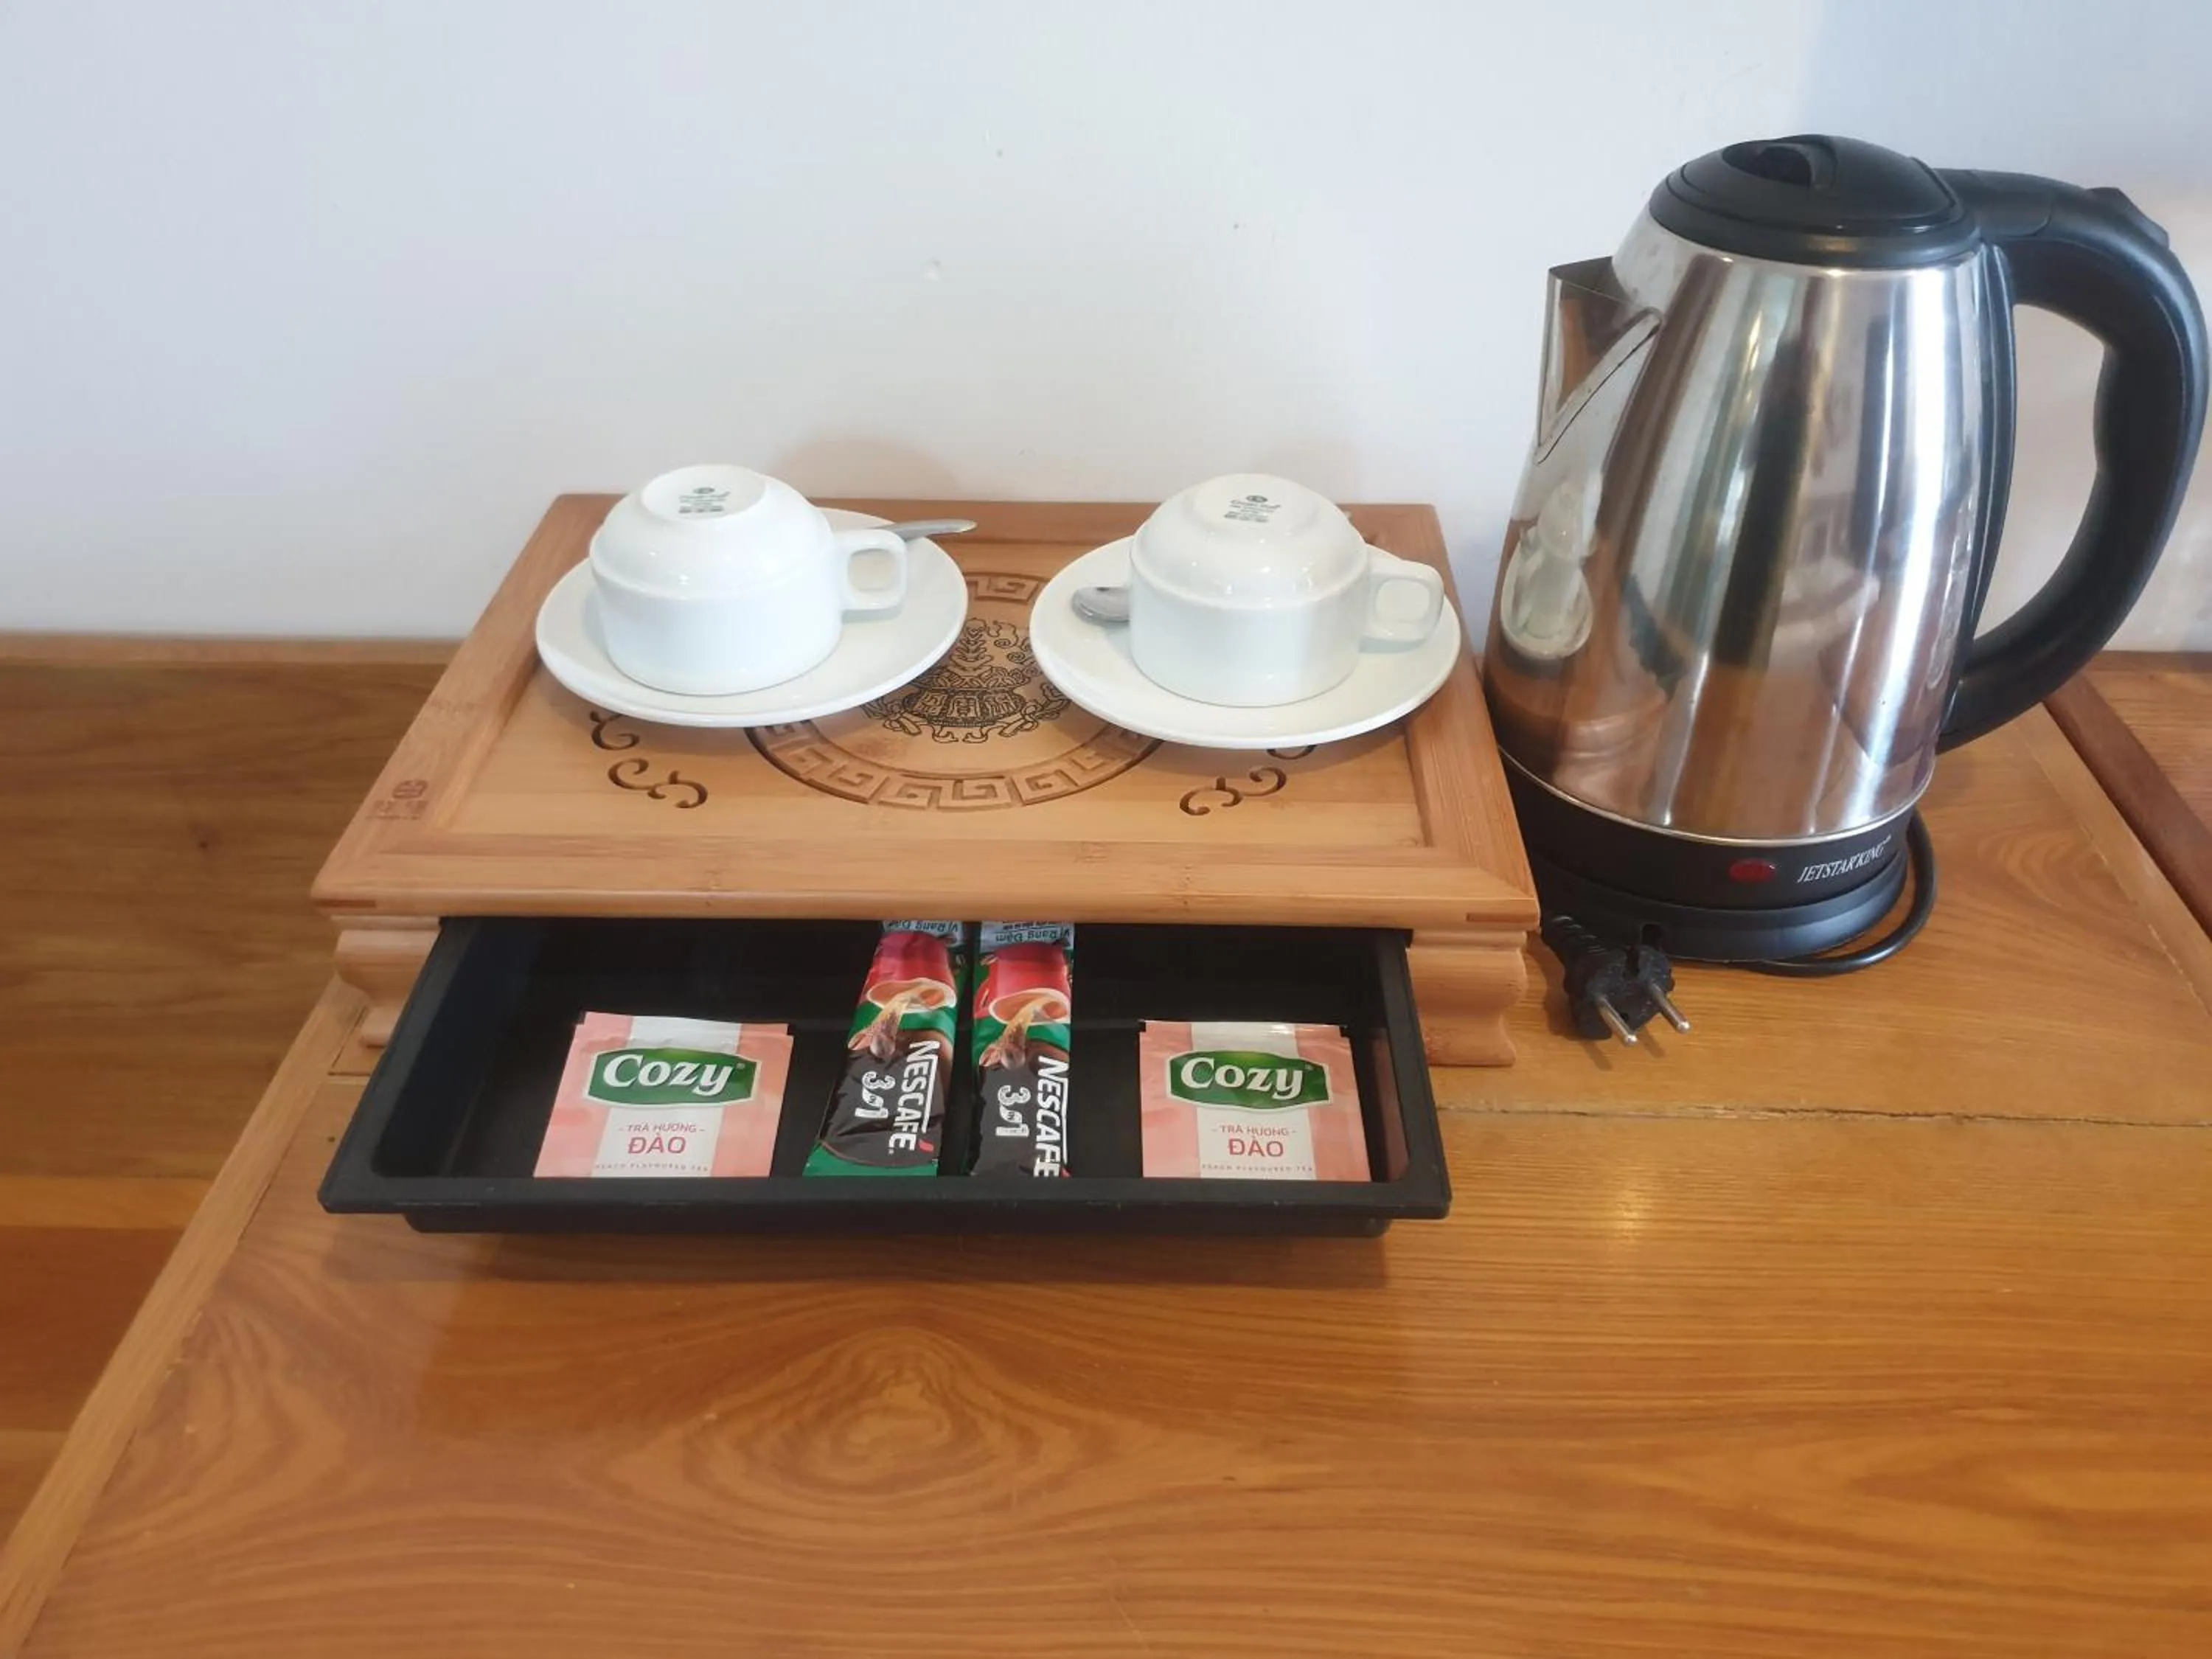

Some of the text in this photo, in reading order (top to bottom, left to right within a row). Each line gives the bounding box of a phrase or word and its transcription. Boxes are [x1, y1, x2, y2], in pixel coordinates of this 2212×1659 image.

[602, 1054, 734, 1096] Cozy
[1180, 1057, 1304, 1100] Cozy
[627, 1133, 686, 1155] ĐÀO
[1228, 1135, 1284, 1158] ĐÀO
